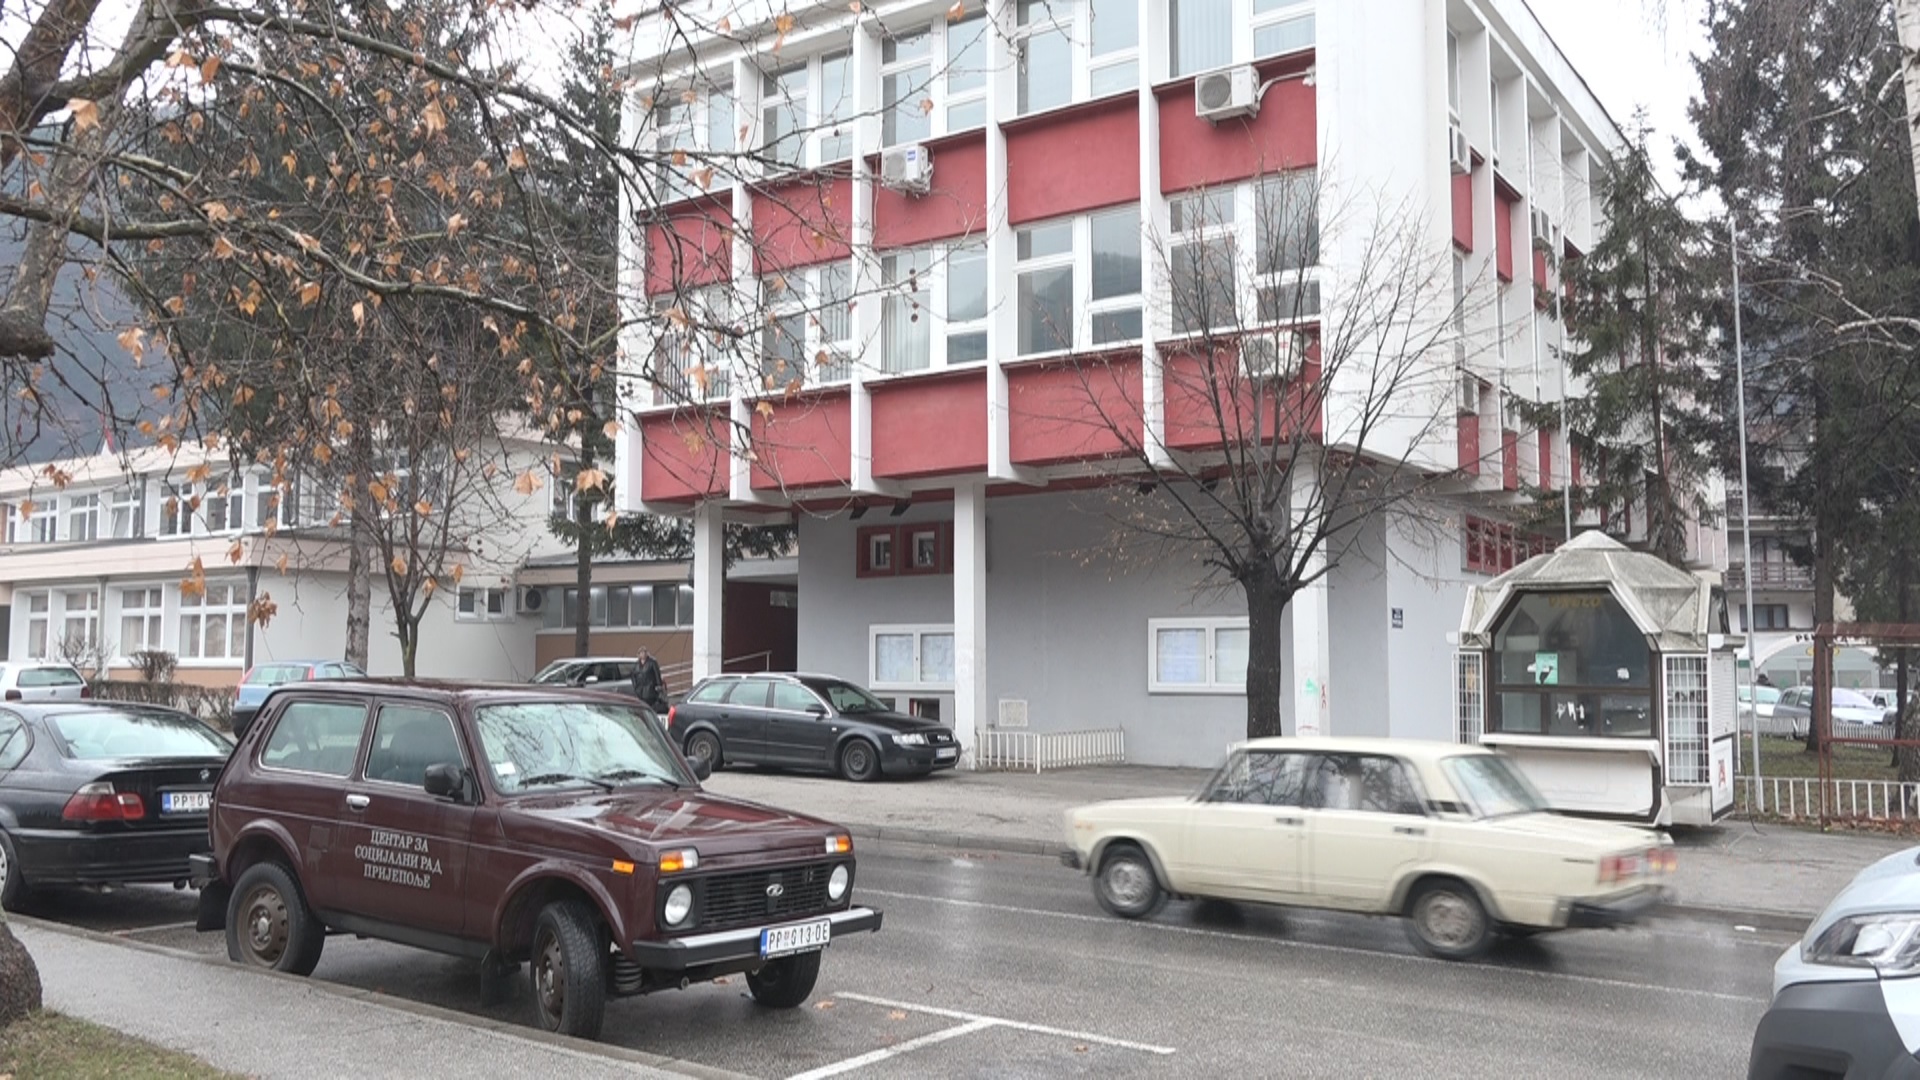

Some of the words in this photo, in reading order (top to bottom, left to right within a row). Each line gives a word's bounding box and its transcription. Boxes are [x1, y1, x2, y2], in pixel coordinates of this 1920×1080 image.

[370, 830, 413, 849] ЦЕНТАР
[414, 838, 429, 853] ЗА
[354, 845, 419, 868] СОЦИЈАЛНИ
[420, 856, 442, 875] РАД
[364, 863, 431, 889] ПРИЈЕПОЉЕ
